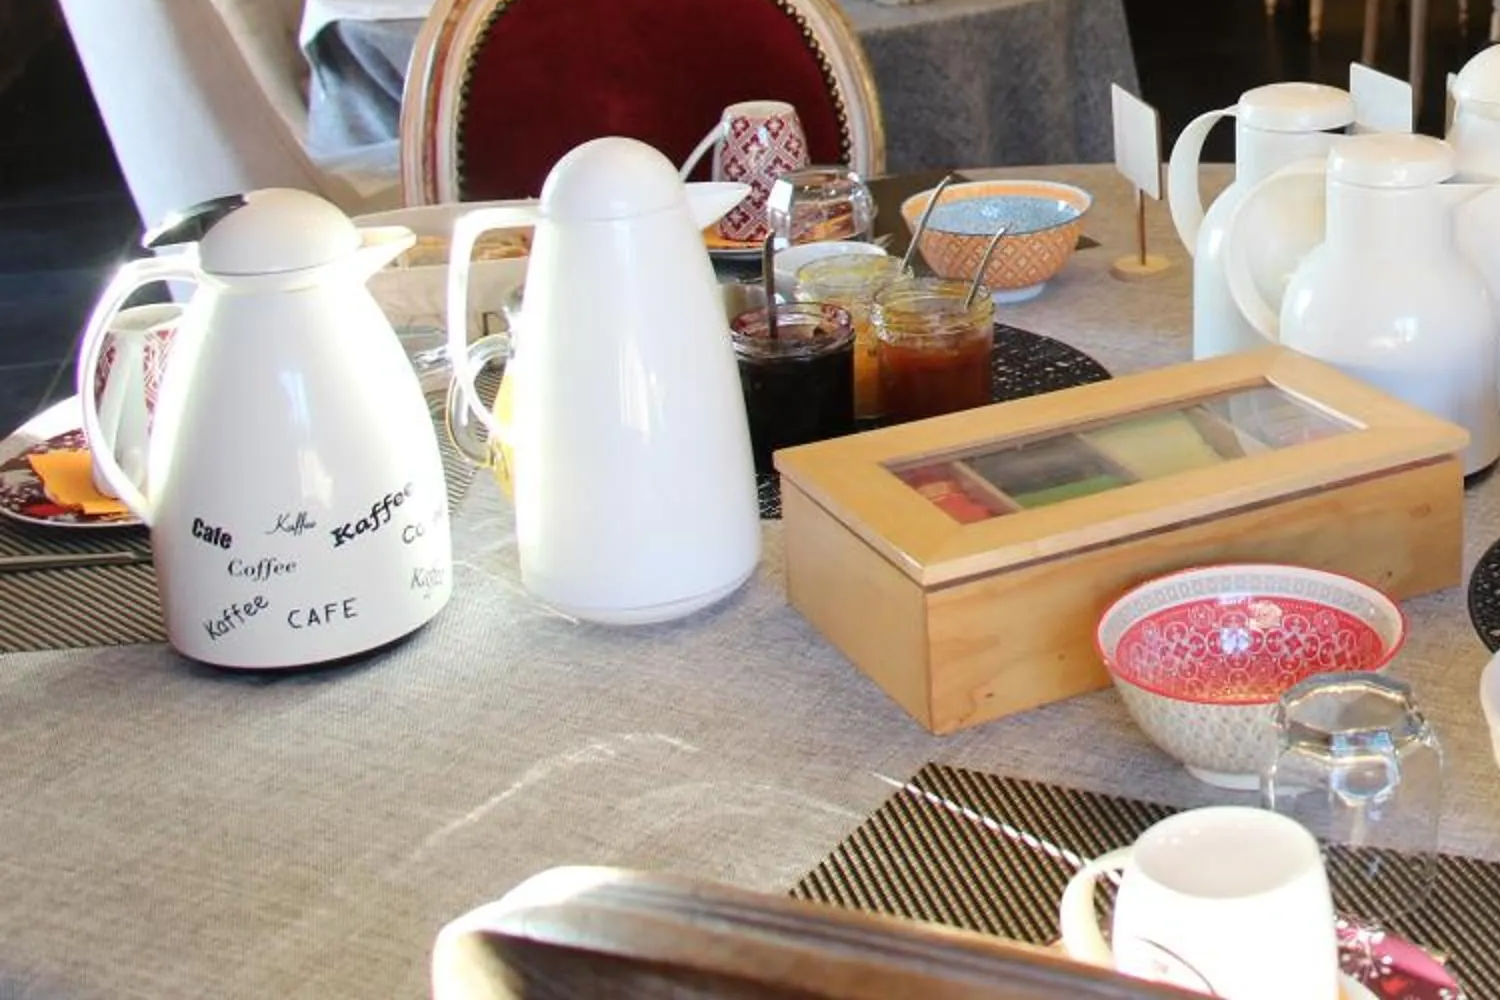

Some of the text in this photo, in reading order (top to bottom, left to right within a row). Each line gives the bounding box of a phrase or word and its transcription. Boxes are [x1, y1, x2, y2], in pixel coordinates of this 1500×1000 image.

[331, 483, 413, 547] Kaffee
[191, 518, 232, 549] Cafe
[227, 557, 297, 581] Coffee
[204, 595, 269, 640] Kaffee
[287, 598, 358, 628] CAFE
